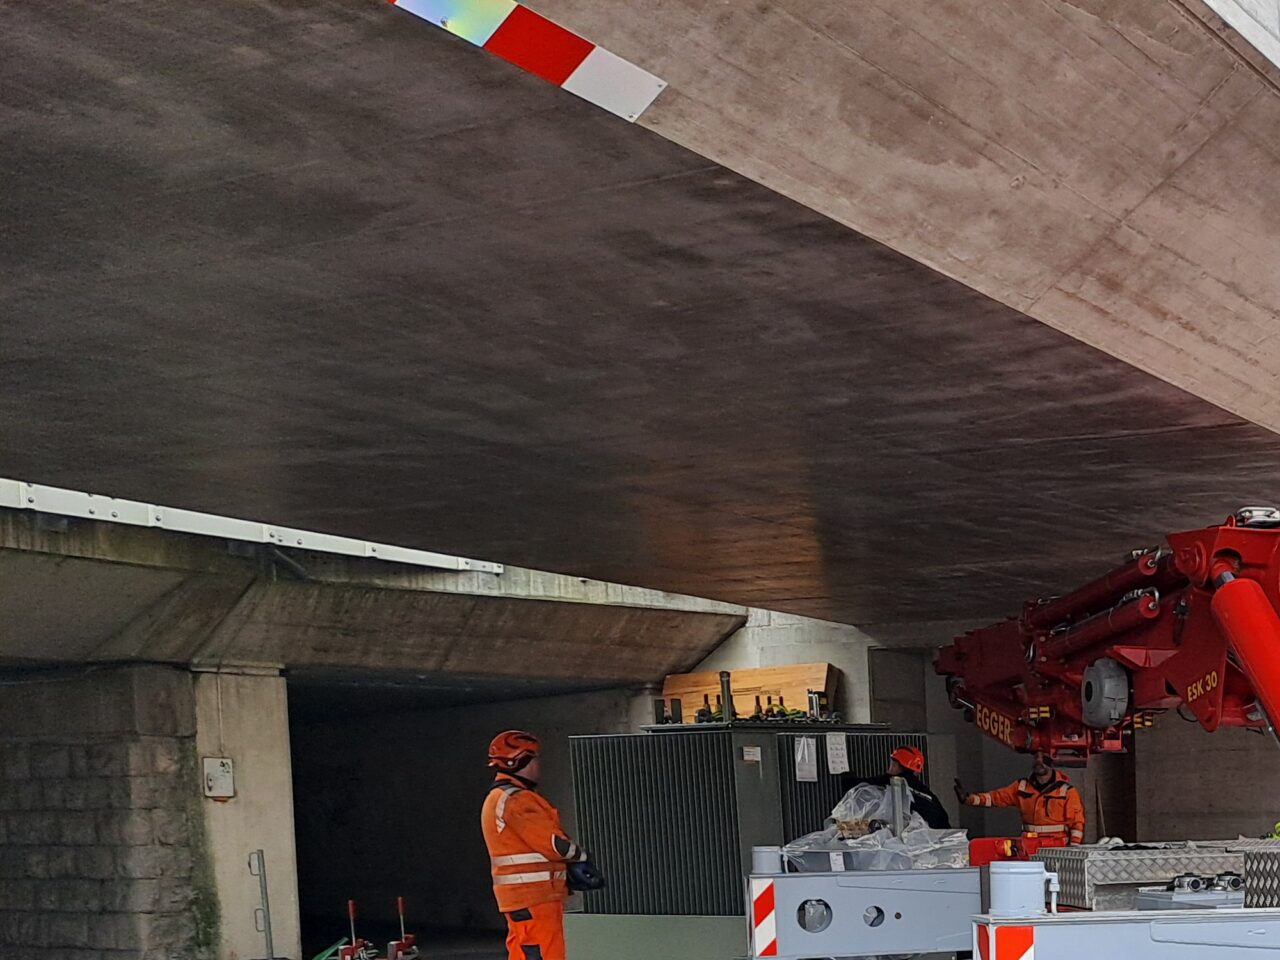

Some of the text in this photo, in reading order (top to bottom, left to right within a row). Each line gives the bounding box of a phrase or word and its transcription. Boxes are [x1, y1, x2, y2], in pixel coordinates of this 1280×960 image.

[1187, 670, 1218, 702] ESK 30
[976, 703, 1012, 745] EGGER
